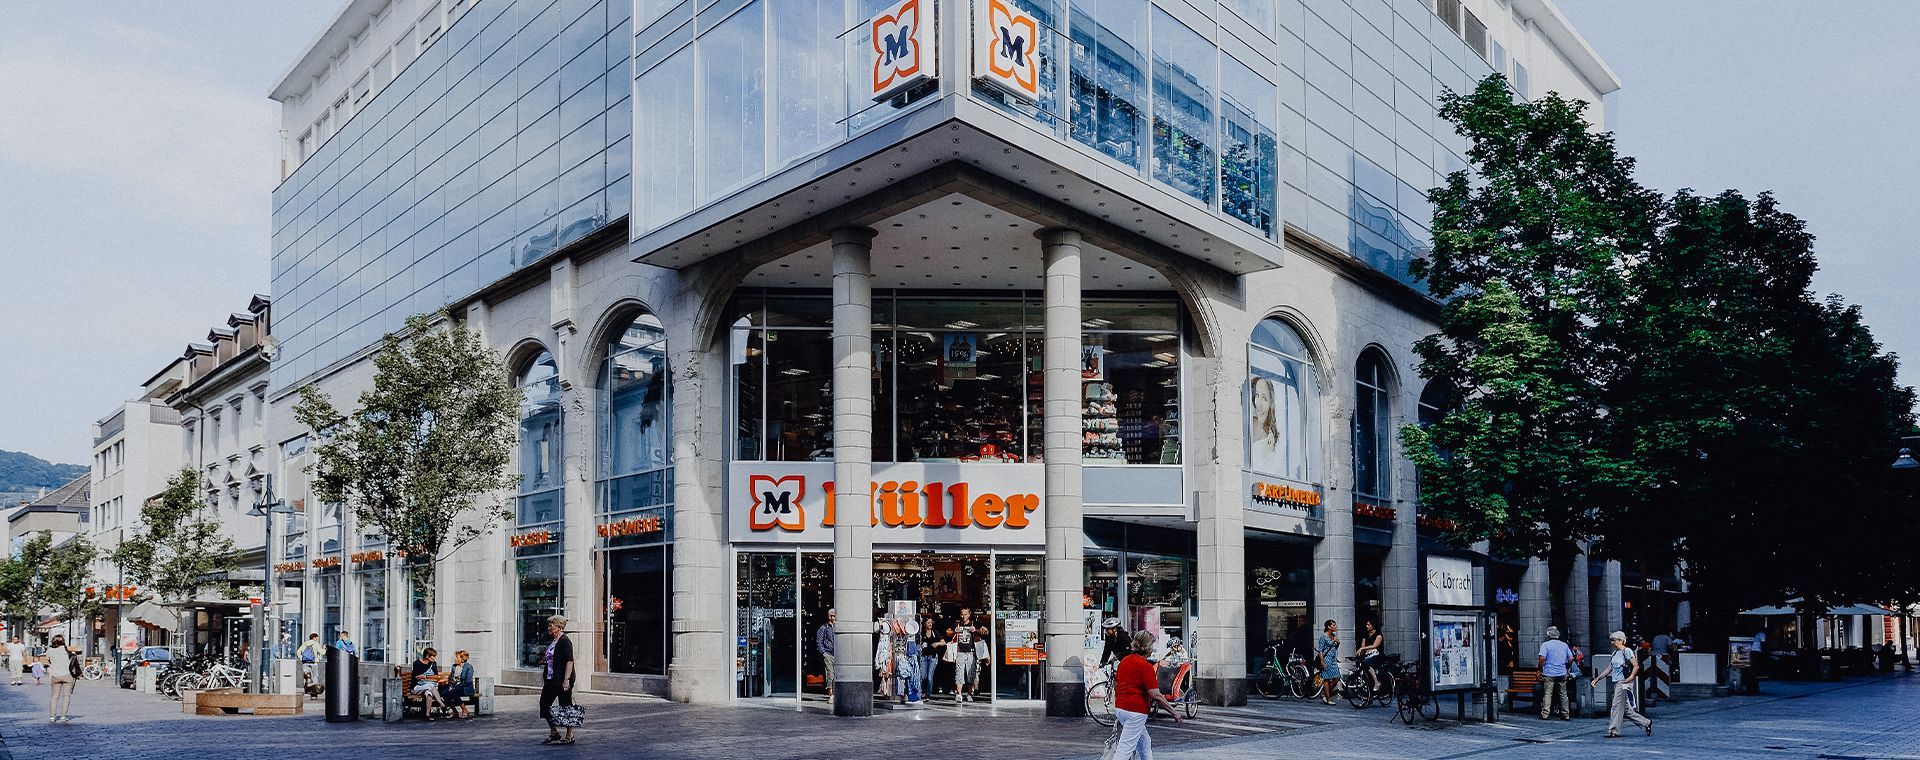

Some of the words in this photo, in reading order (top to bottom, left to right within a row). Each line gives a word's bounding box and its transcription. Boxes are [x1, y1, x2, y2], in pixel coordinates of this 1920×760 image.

[884, 25, 909, 66] M
[1000, 26, 1024, 67] M
[763, 491, 792, 514] M
[1258, 481, 1321, 506] PARFÜMERIE
[597, 516, 660, 538] PARFÜMERIE
[1443, 572, 1472, 590] Lörrach
